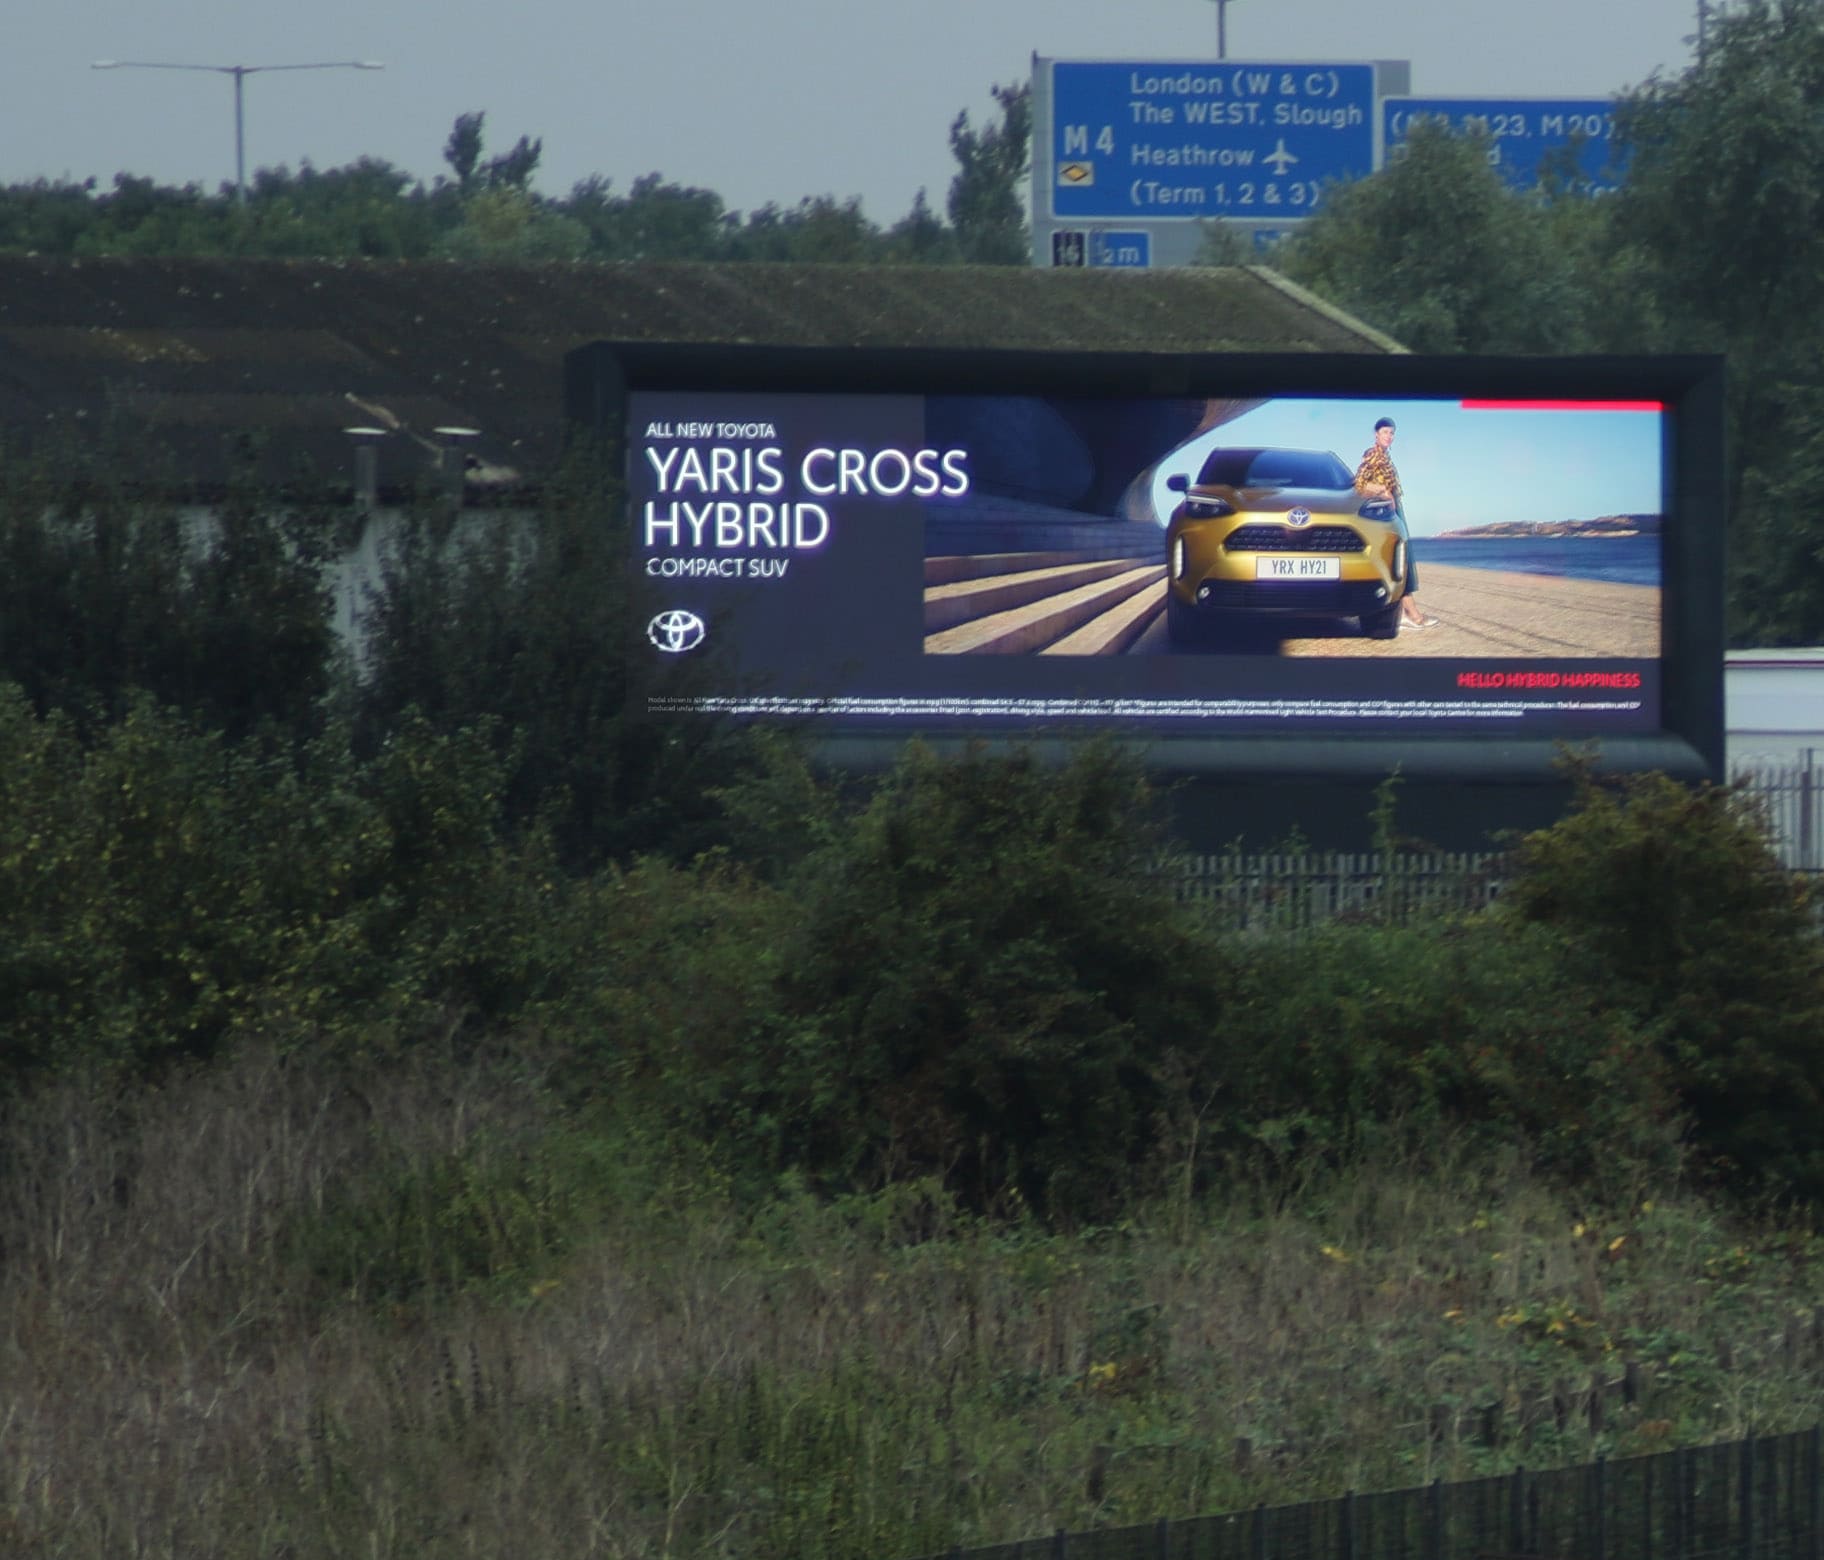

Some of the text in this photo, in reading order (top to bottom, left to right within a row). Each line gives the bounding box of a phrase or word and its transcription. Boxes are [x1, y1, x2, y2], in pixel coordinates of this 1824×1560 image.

[1130, 70, 1340, 98] London (W & C)
[1129, 102, 1363, 129] The WEST, Slough
[1130, 144, 1255, 166] Heathrow
[1130, 179, 1206, 207] (Term
[1239, 182, 1255, 205] 2
[1263, 183, 1281, 205] &
[1290, 180, 1320, 207] 3)
[646, 422, 775, 439] ALL NEW TOYOTA
[645, 446, 970, 496] YARIS CROSS
[644, 501, 830, 549] HYBRID
[646, 557, 790, 578] COMPACT SUV
[1272, 559, 1327, 575] YRX HY21
[1457, 672, 1642, 689] HELLO HYBRID HAPPINESS
